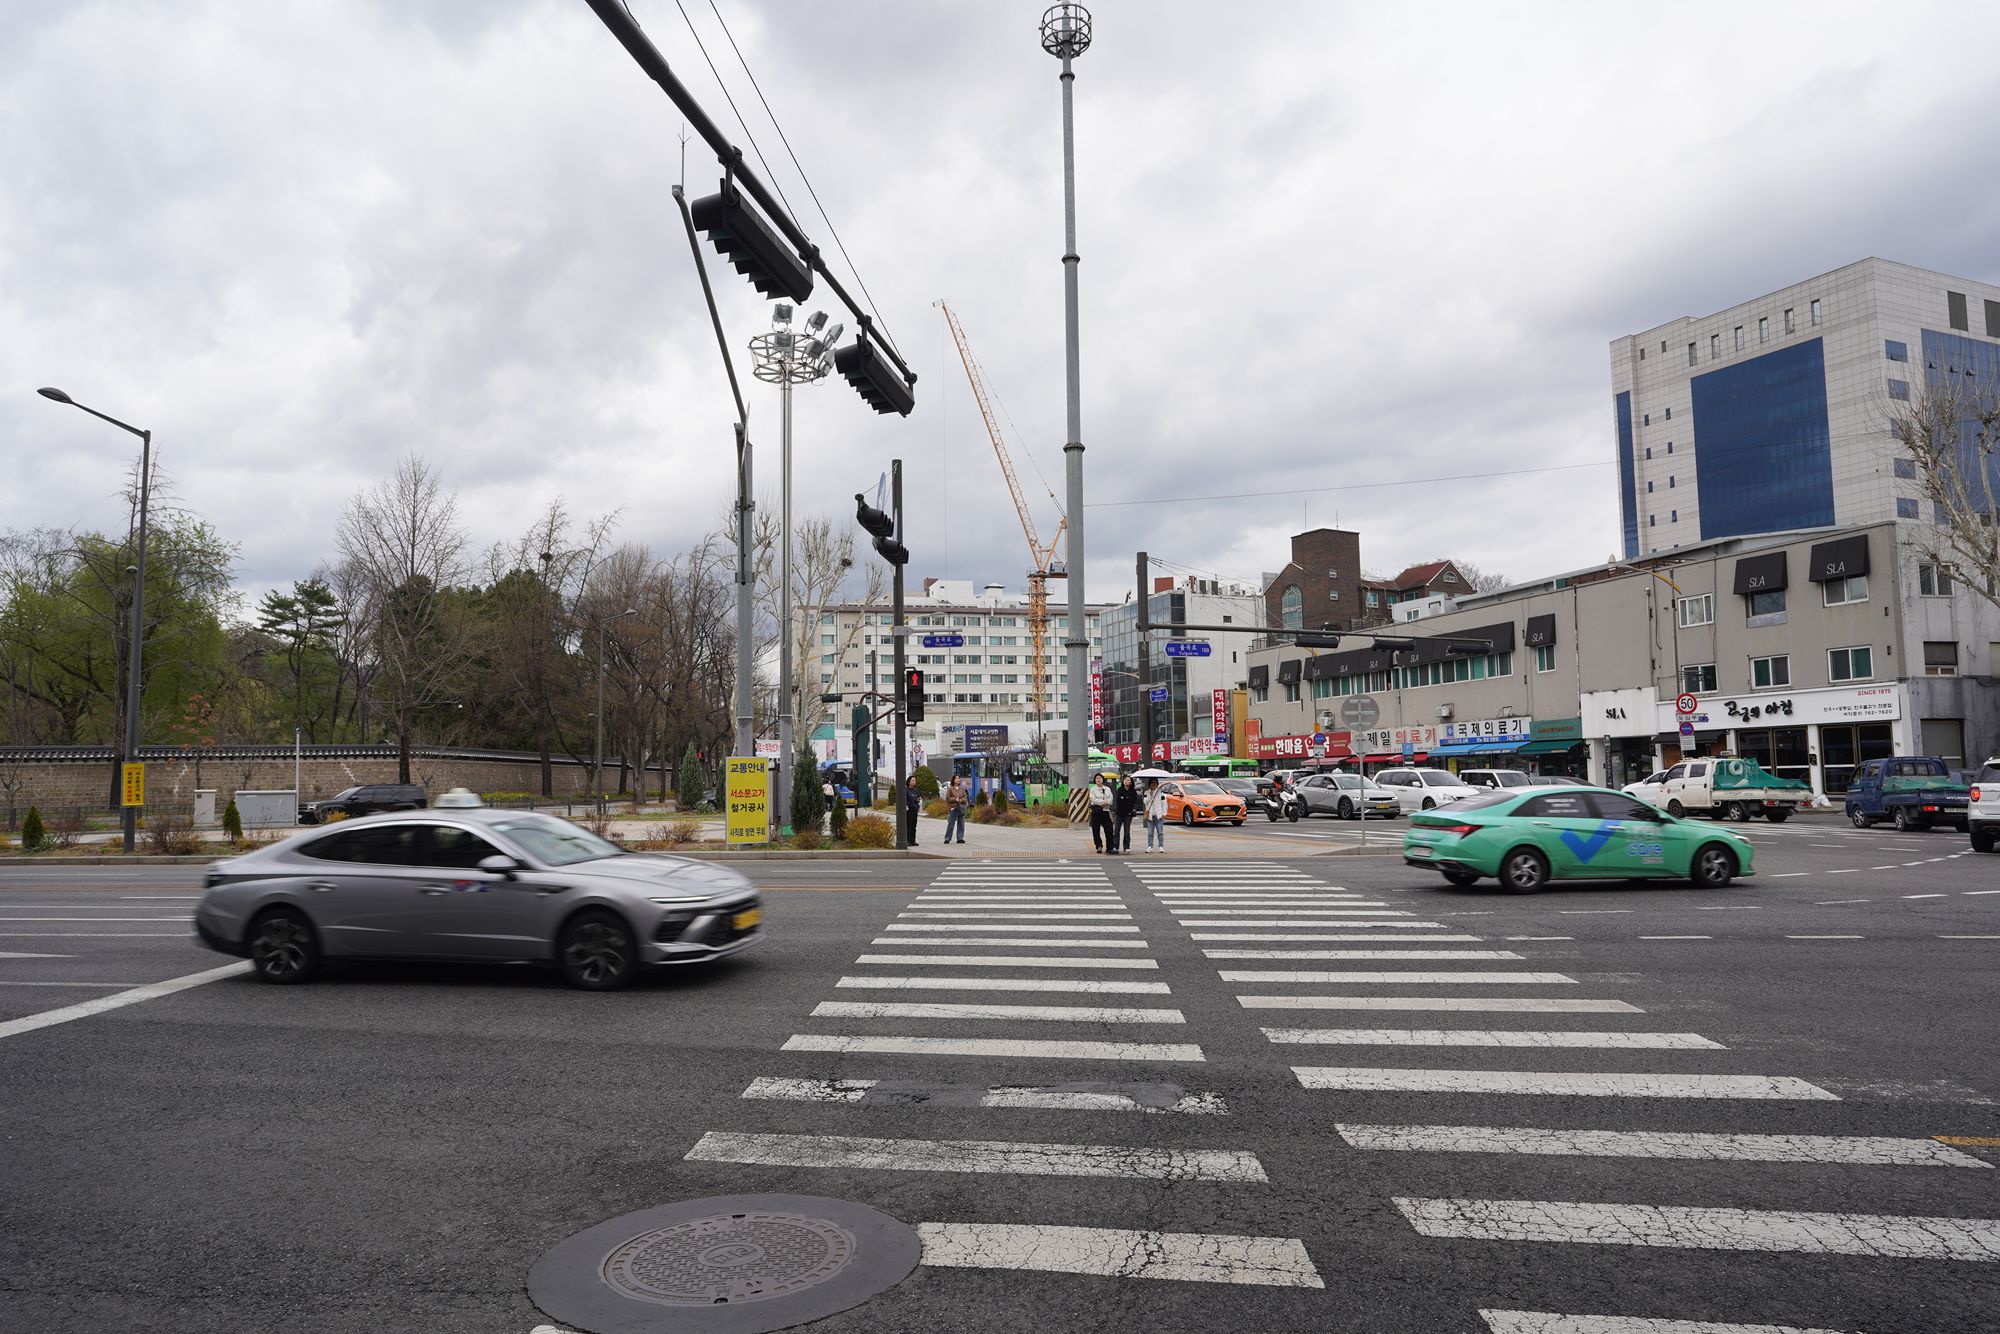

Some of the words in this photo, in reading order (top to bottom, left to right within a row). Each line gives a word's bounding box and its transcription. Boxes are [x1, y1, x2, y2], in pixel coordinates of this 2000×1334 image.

[1826, 561, 1845, 575] SLA
[1749, 576, 1765, 588] SLA
[1532, 632, 1543, 643] SLA
[1410, 653, 1419, 663] SLA
[1339, 665, 1348, 673] SLA
[1369, 660, 1378, 669] SLA
[1252, 678, 1260, 686] SLA
[1283, 673, 1291, 681] SLA
[1093, 676, 1101, 728] 대학약국
[1680, 698, 1694, 710] 50
[1215, 690, 1225, 732] 대학약국
[1605, 707, 1626, 719] SLA
[1724, 700, 1760, 722] 고궁의
[1765, 699, 1793, 716] 아침
[1458, 719, 1522, 736] 국제의료기
[1367, 731, 1391, 747] 제일
[1395, 727, 1438, 746] 의료기
[1275, 738, 1302, 755] 한마음
[730, 763, 765, 774] 교통안내
[730, 788, 765, 798] 서소문고가
[731, 802, 765, 813] 철거공사
[756, 826, 766, 837] 우회
